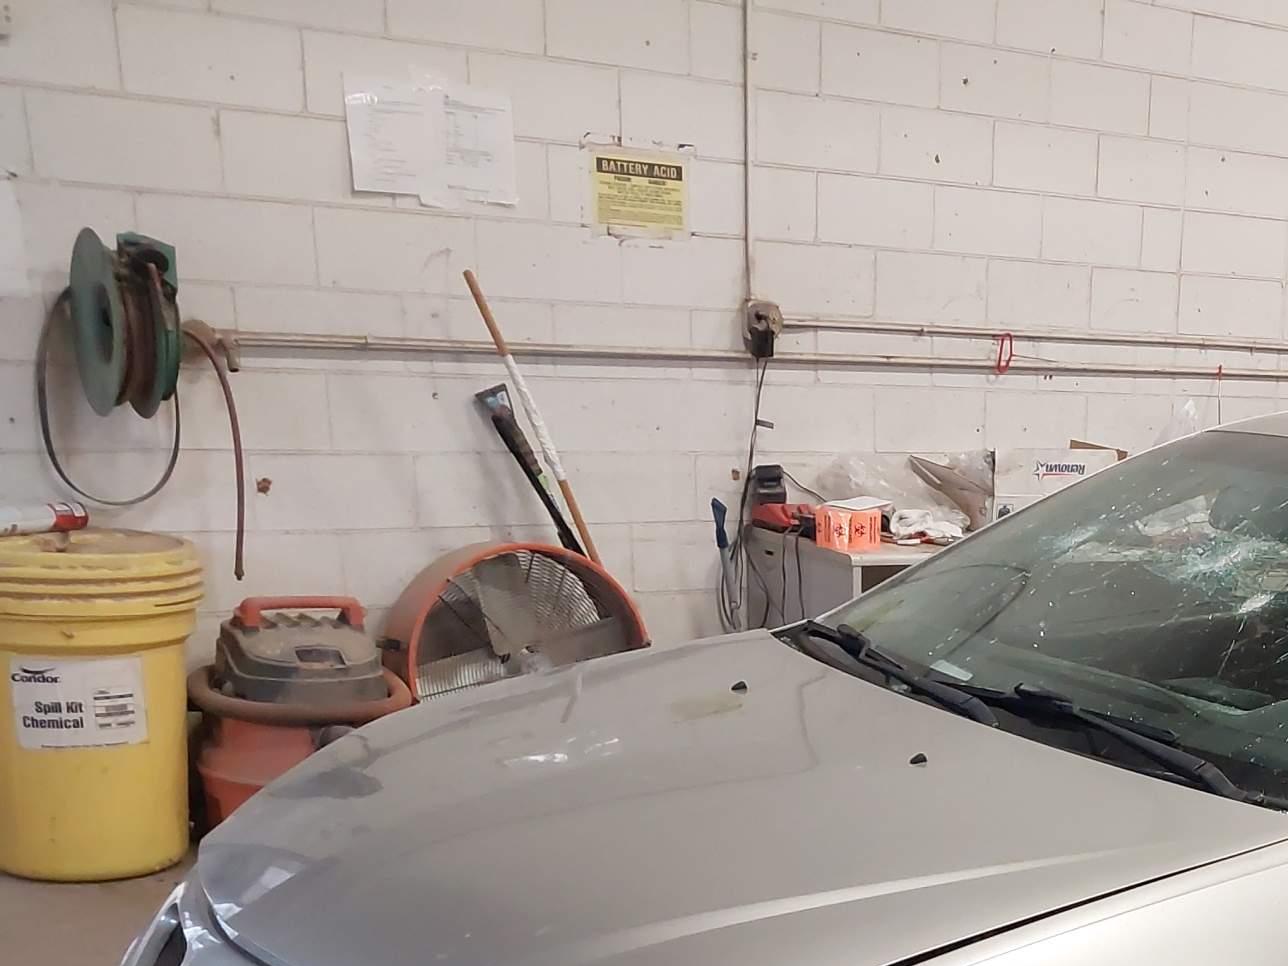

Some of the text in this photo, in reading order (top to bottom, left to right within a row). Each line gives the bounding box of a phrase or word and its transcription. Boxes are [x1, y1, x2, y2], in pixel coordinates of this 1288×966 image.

[601, 159, 677, 179] BATTERY ACID
[1045, 463, 1086, 476] Renown
[11, 672, 61, 684] Condor
[34, 701, 84, 715] Spill Kit
[22, 715, 84, 729] Chemical
